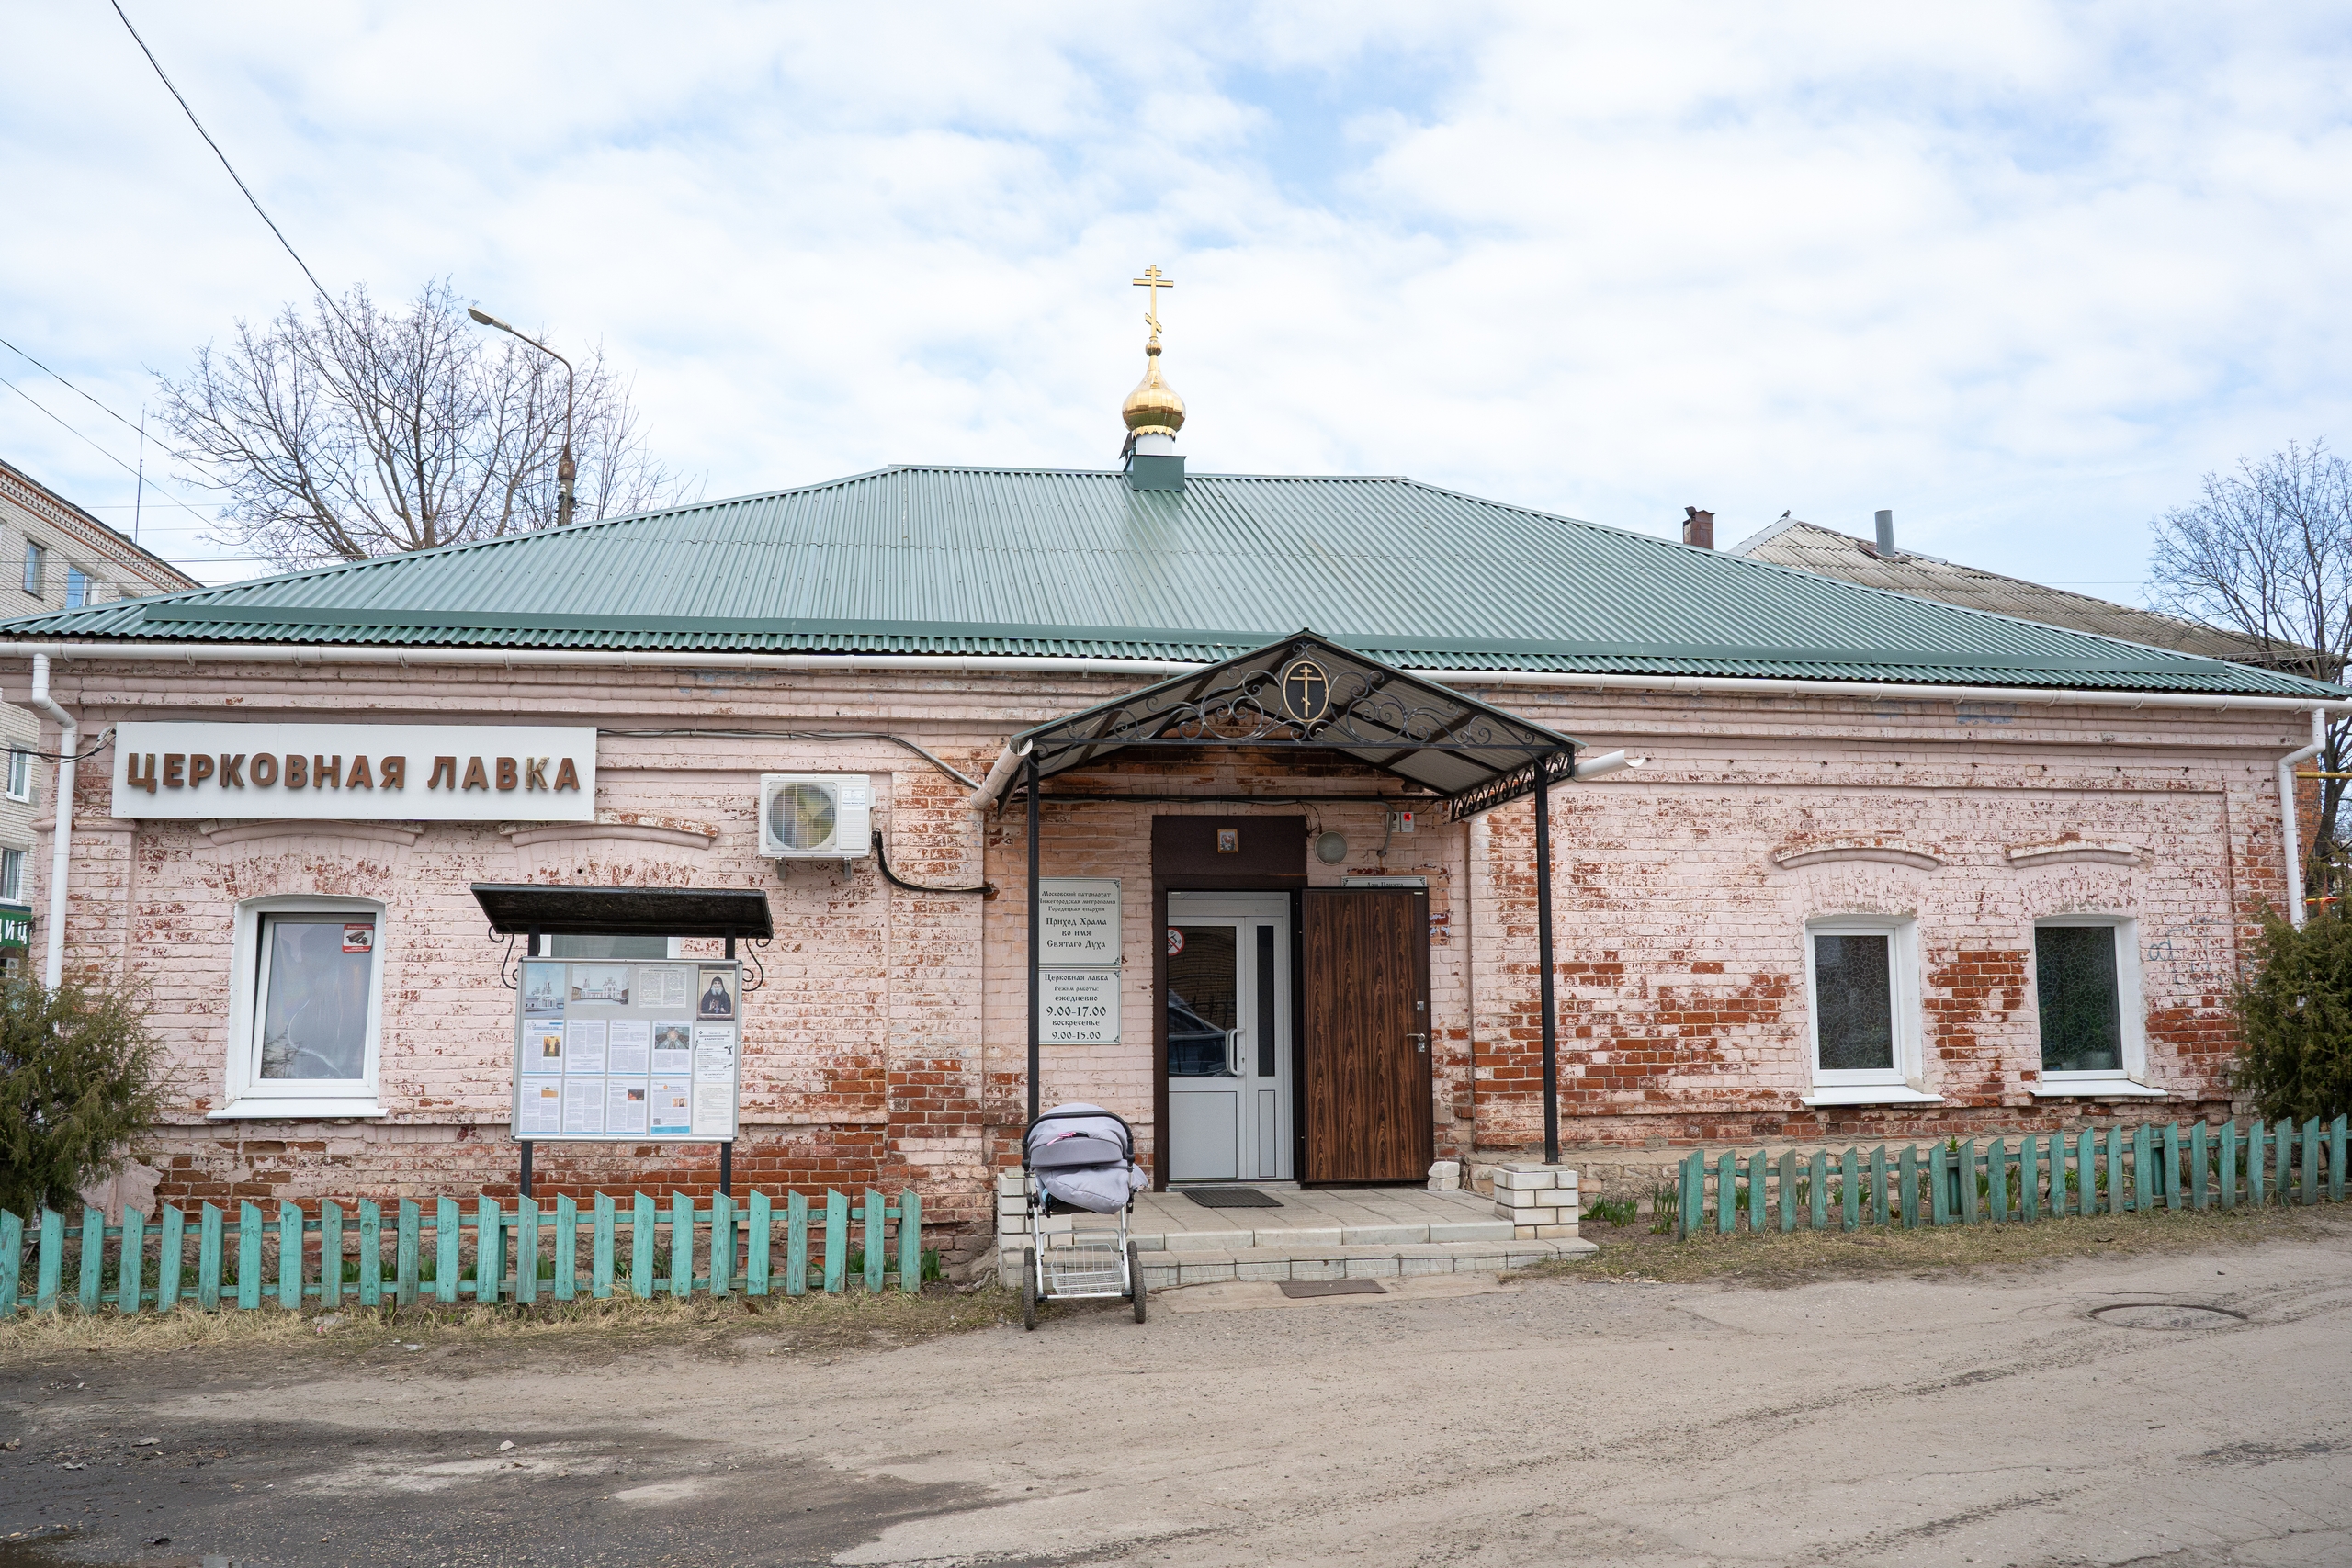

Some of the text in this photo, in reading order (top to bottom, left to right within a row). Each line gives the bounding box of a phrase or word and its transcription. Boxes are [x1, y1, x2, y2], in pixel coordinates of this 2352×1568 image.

[127, 751, 581, 794] ЦЕРКОВНАЯ ЛАВКА
[1046, 917, 1107, 928] Приход Храма
[1046, 940, 1106, 950] Святаго Духа
[1045, 973, 1085, 982] Церковная
[1046, 1006, 1107, 1017] 9.00-17.00
[1052, 1020, 1100, 1028] воскресенье
[1051, 1031, 1101, 1040] 9.00-15.00
